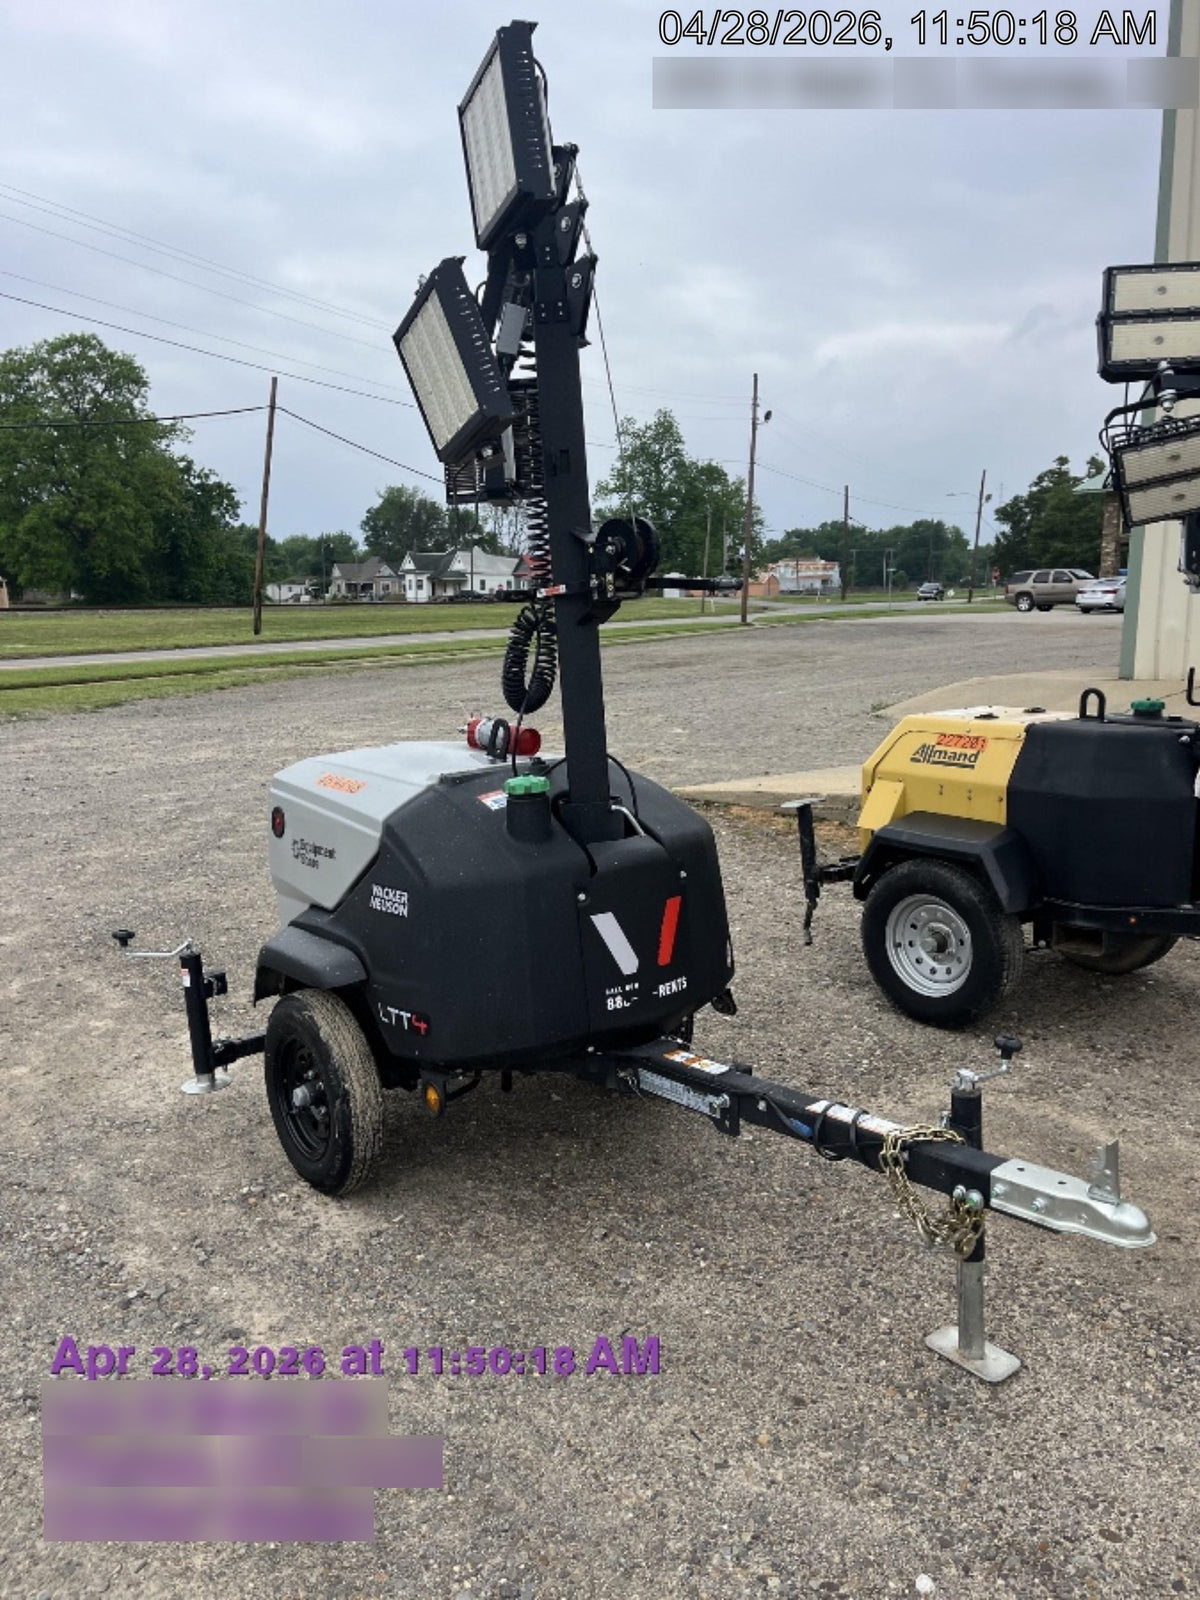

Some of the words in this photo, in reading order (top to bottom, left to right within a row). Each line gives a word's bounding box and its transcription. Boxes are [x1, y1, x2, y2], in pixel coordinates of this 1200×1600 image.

[371, 884, 408, 903] WACKER
[369, 895, 408, 918] NEUSON
[378, 1002, 428, 1035] LTT4
